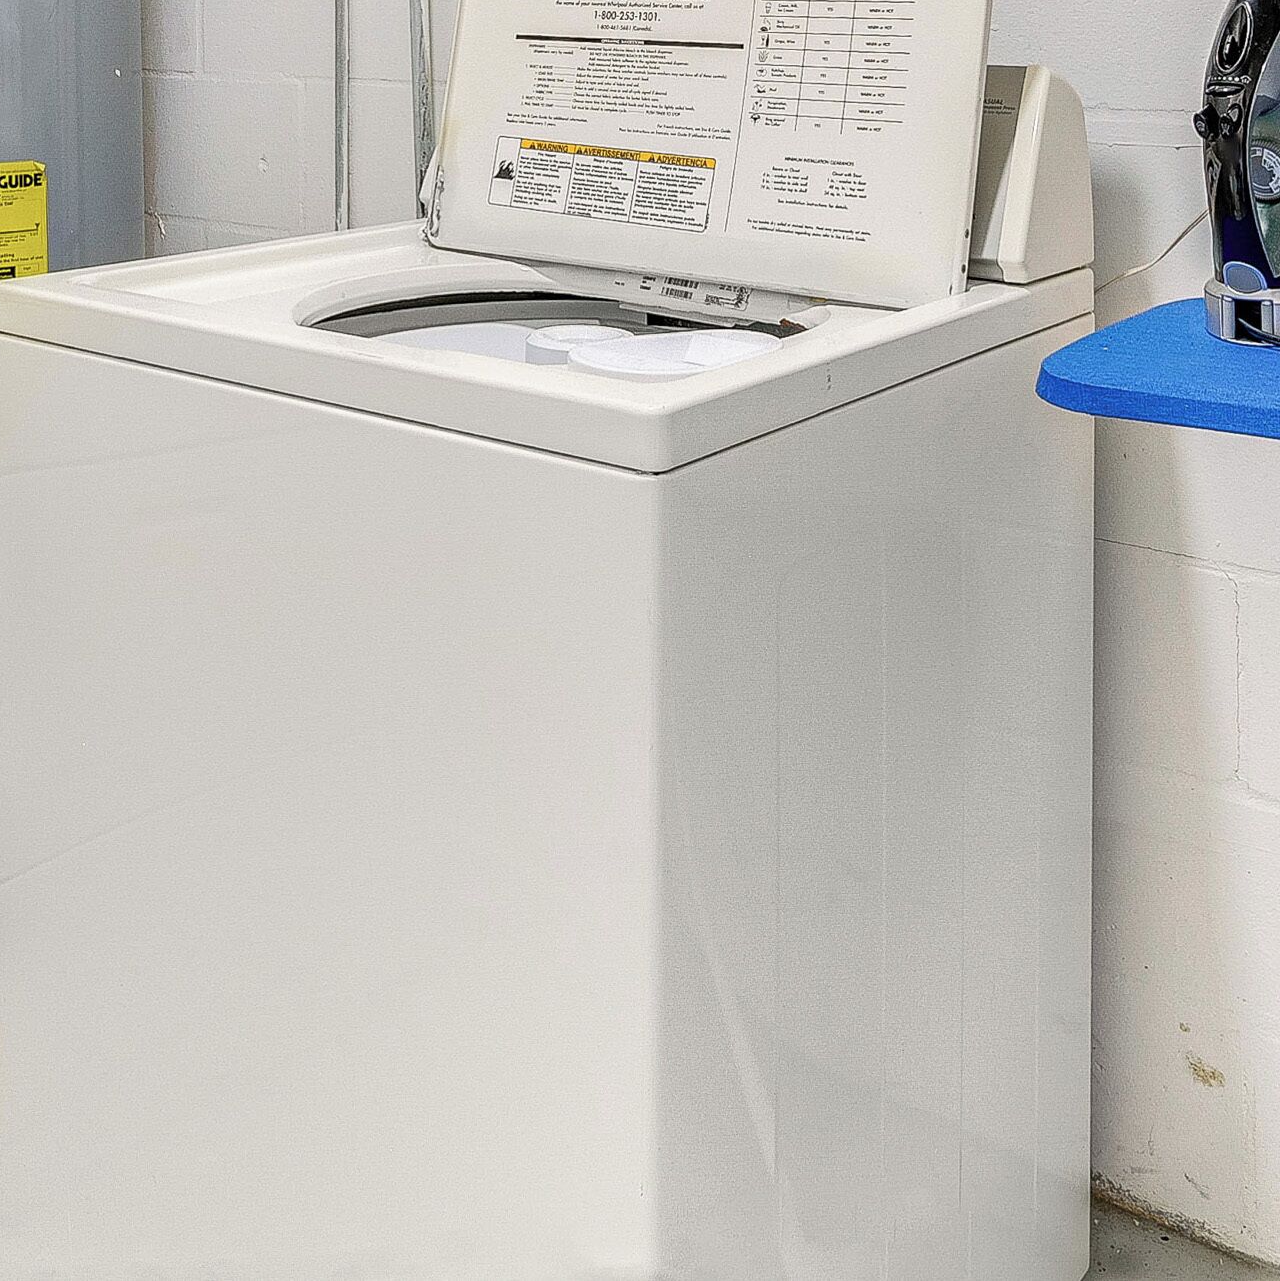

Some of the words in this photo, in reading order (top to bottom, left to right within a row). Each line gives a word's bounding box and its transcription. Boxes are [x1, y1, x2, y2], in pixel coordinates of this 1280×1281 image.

[594, 10, 660, 22] 1-800-253-1301.
[537, 142, 569, 153] WARNING
[584, 148, 640, 160] AVERTISSEMENT
[658, 154, 707, 167] ADVERTENCIA
